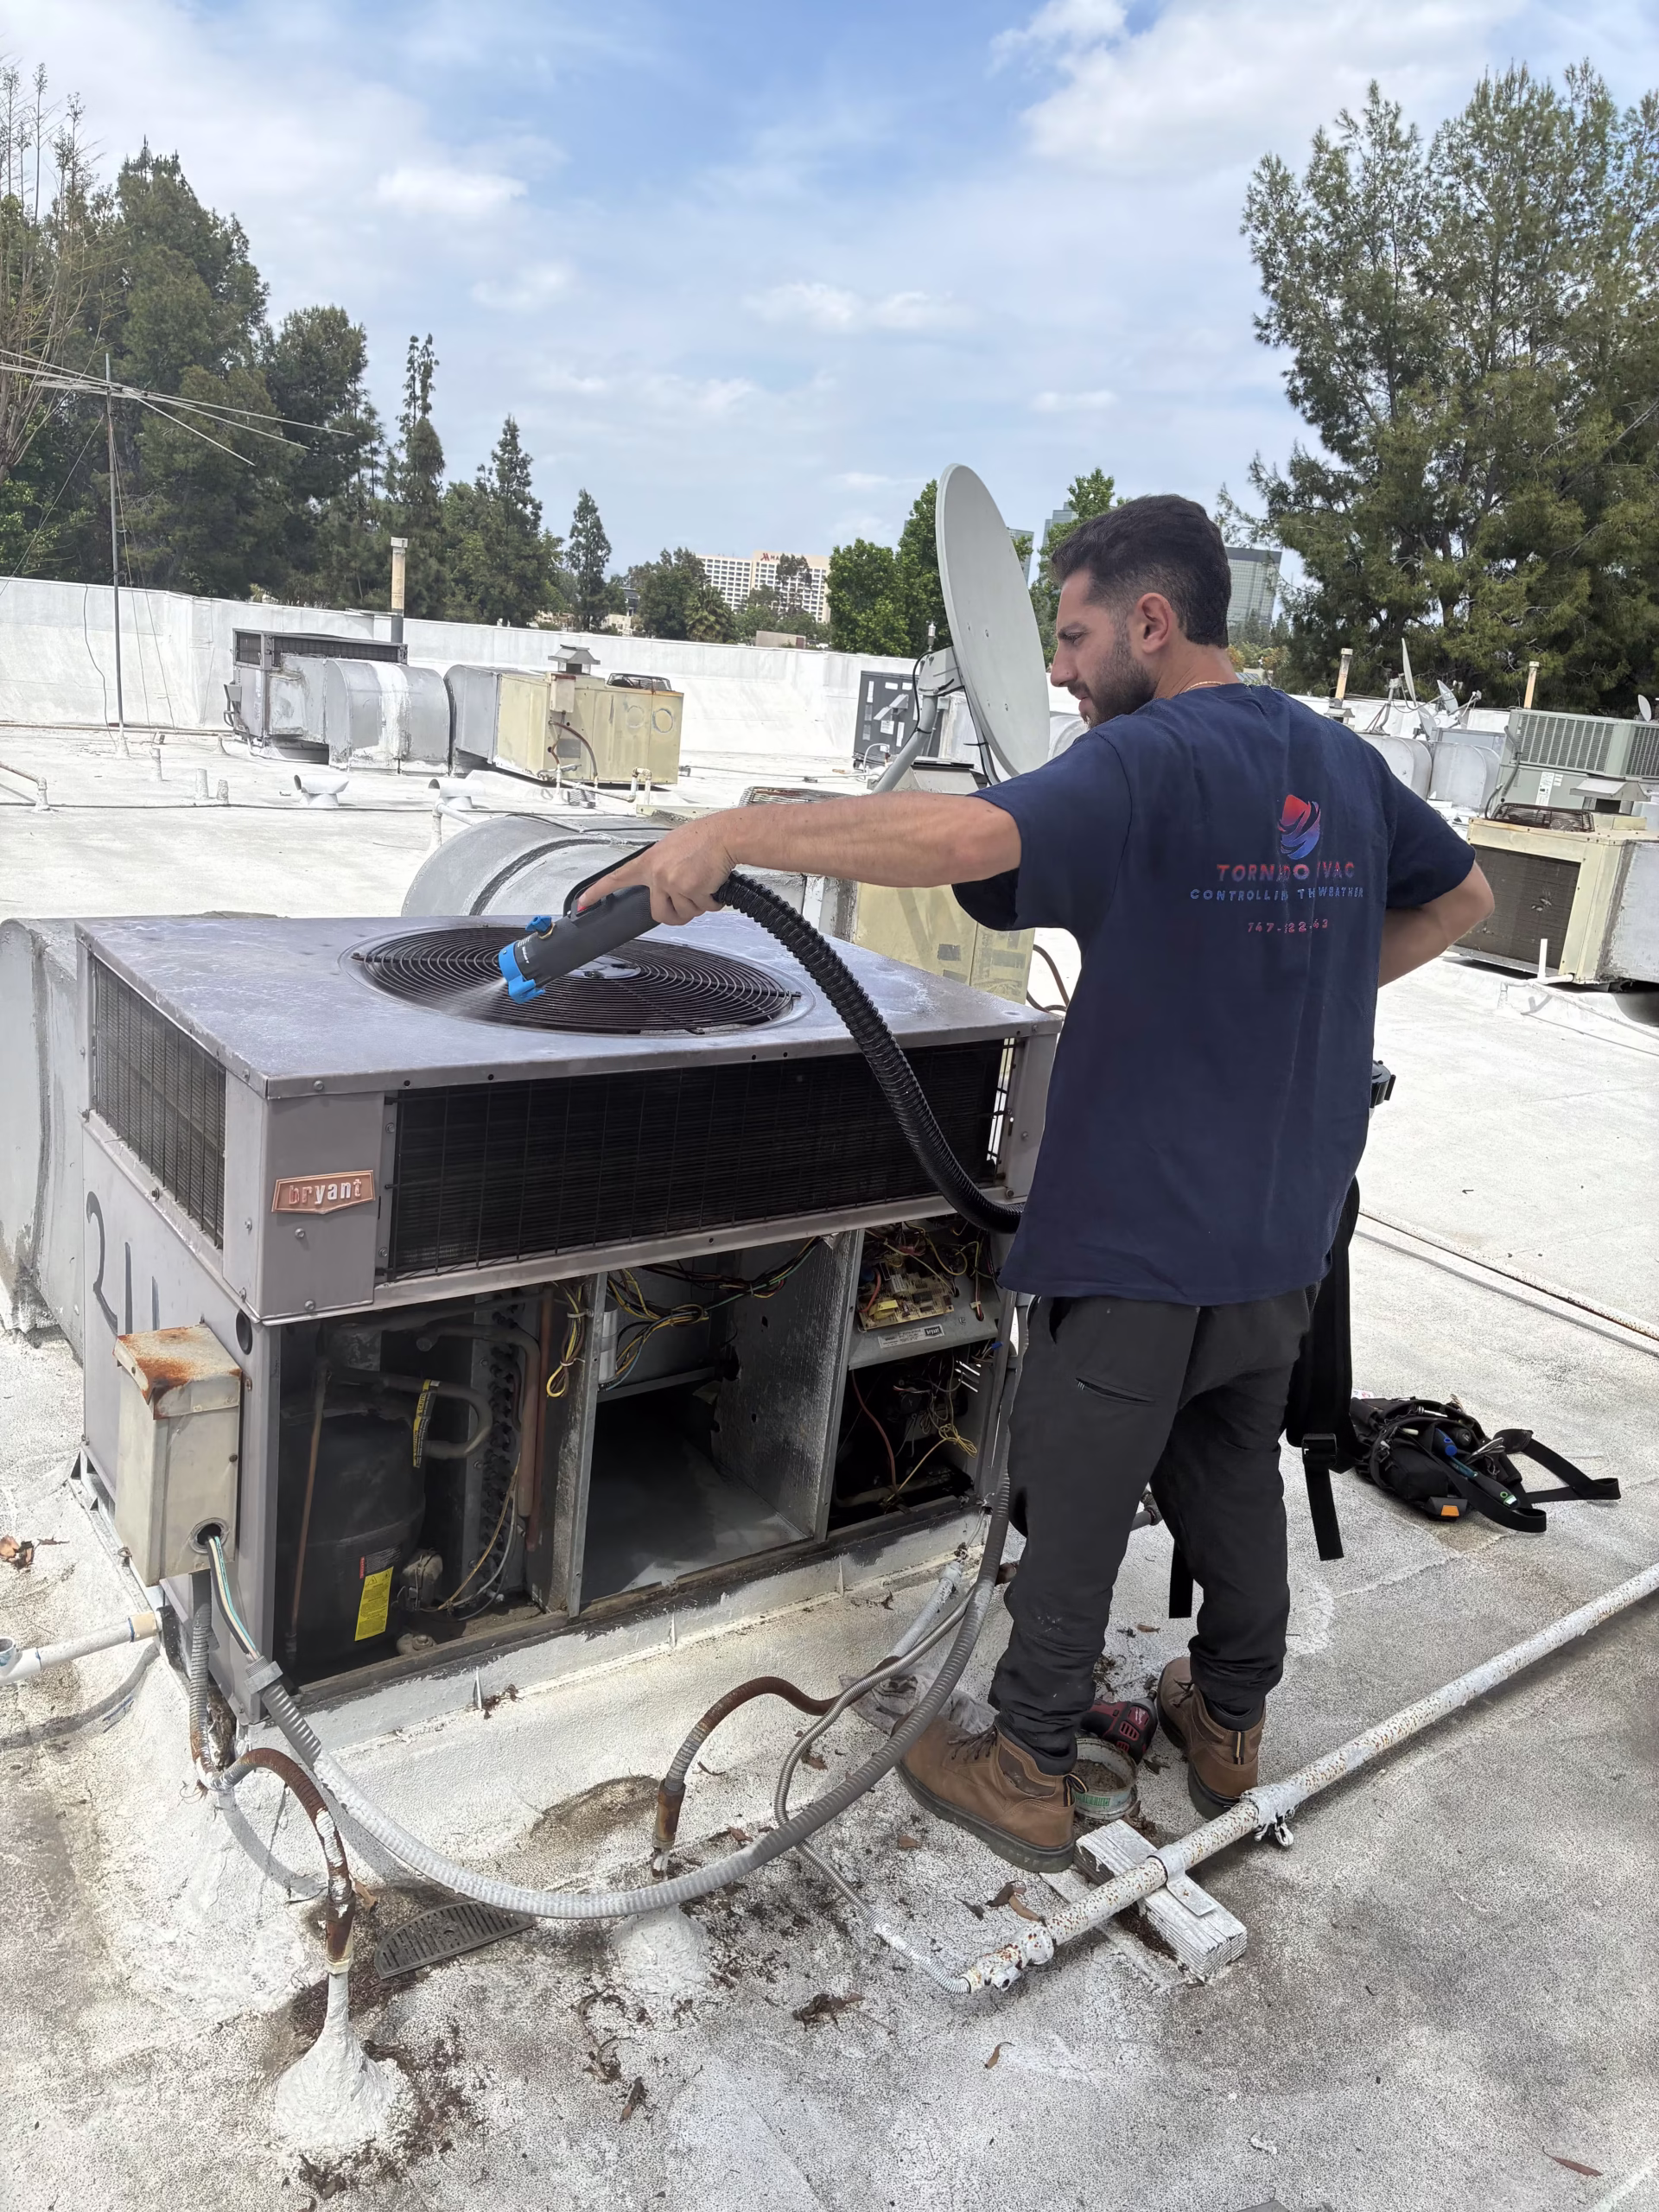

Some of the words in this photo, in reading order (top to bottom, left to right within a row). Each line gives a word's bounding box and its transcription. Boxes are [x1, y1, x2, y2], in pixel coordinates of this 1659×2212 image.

[1316, 861, 1355, 879] VAC
[1190, 888, 1288, 901] CONTROLLIN
[1297, 887, 1315, 899] TH
[1318, 887, 1363, 898] WEATHER
[289, 1179, 362, 1205] bryant
